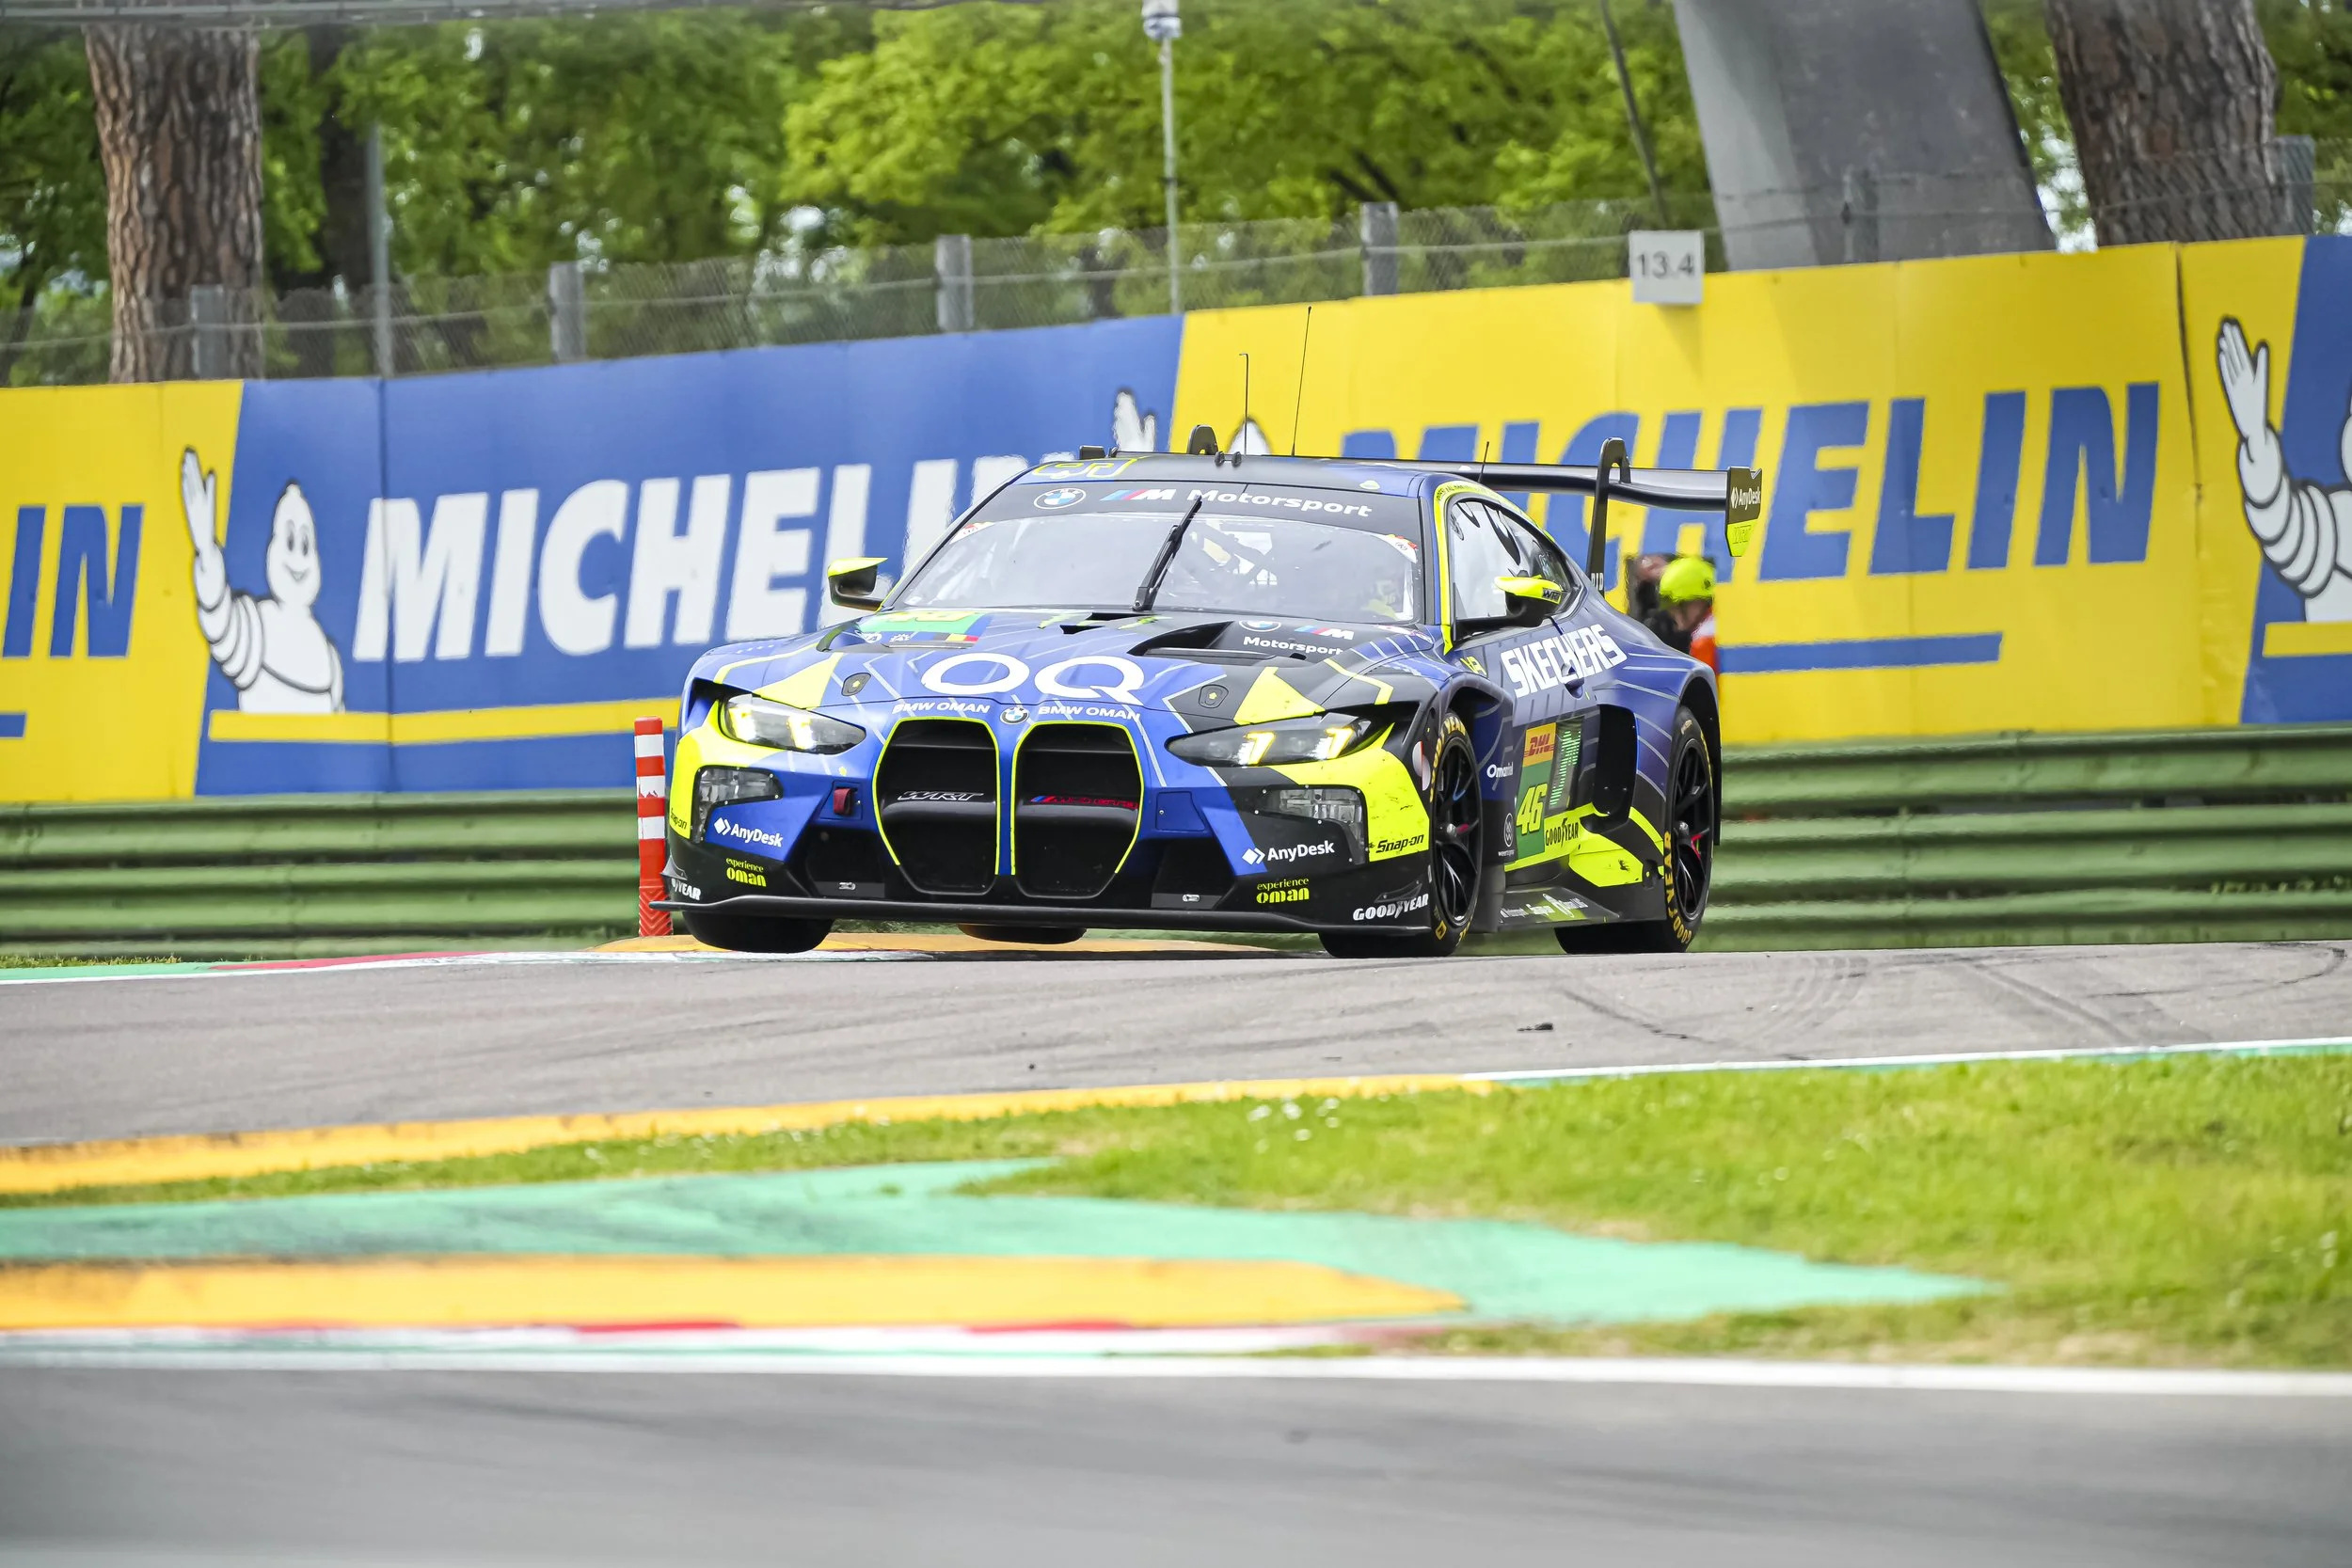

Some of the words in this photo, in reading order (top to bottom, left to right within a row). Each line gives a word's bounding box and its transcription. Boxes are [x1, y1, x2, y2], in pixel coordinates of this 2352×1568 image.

[1635, 250, 1696, 280] 13.4
[1187, 489, 1373, 517] Motorsport
[1739, 485, 1761, 510] AnyDesk
[1501, 624, 1629, 698] SKECHERS
[921, 653, 1145, 705] OQ
[892, 701, 935, 715] BMW
[933, 702, 991, 715] OMAN
[1038, 705, 1085, 717] BMW
[1085, 707, 1141, 721] OMAN
[897, 791, 984, 801] WRT
[1517, 783, 1549, 836] 46
[730, 823, 784, 847] AnyDesk
[1375, 833, 1424, 853] Snap-on
[1545, 816, 1580, 847] GOODYEAR
[1266, 840, 1335, 863] AnyDesk
[725, 857, 764, 873] experience
[726, 866, 767, 888] oman
[1256, 877, 1310, 891] experience
[1256, 887, 1310, 904] oman
[1352, 893, 1430, 922] GOODYEAR
